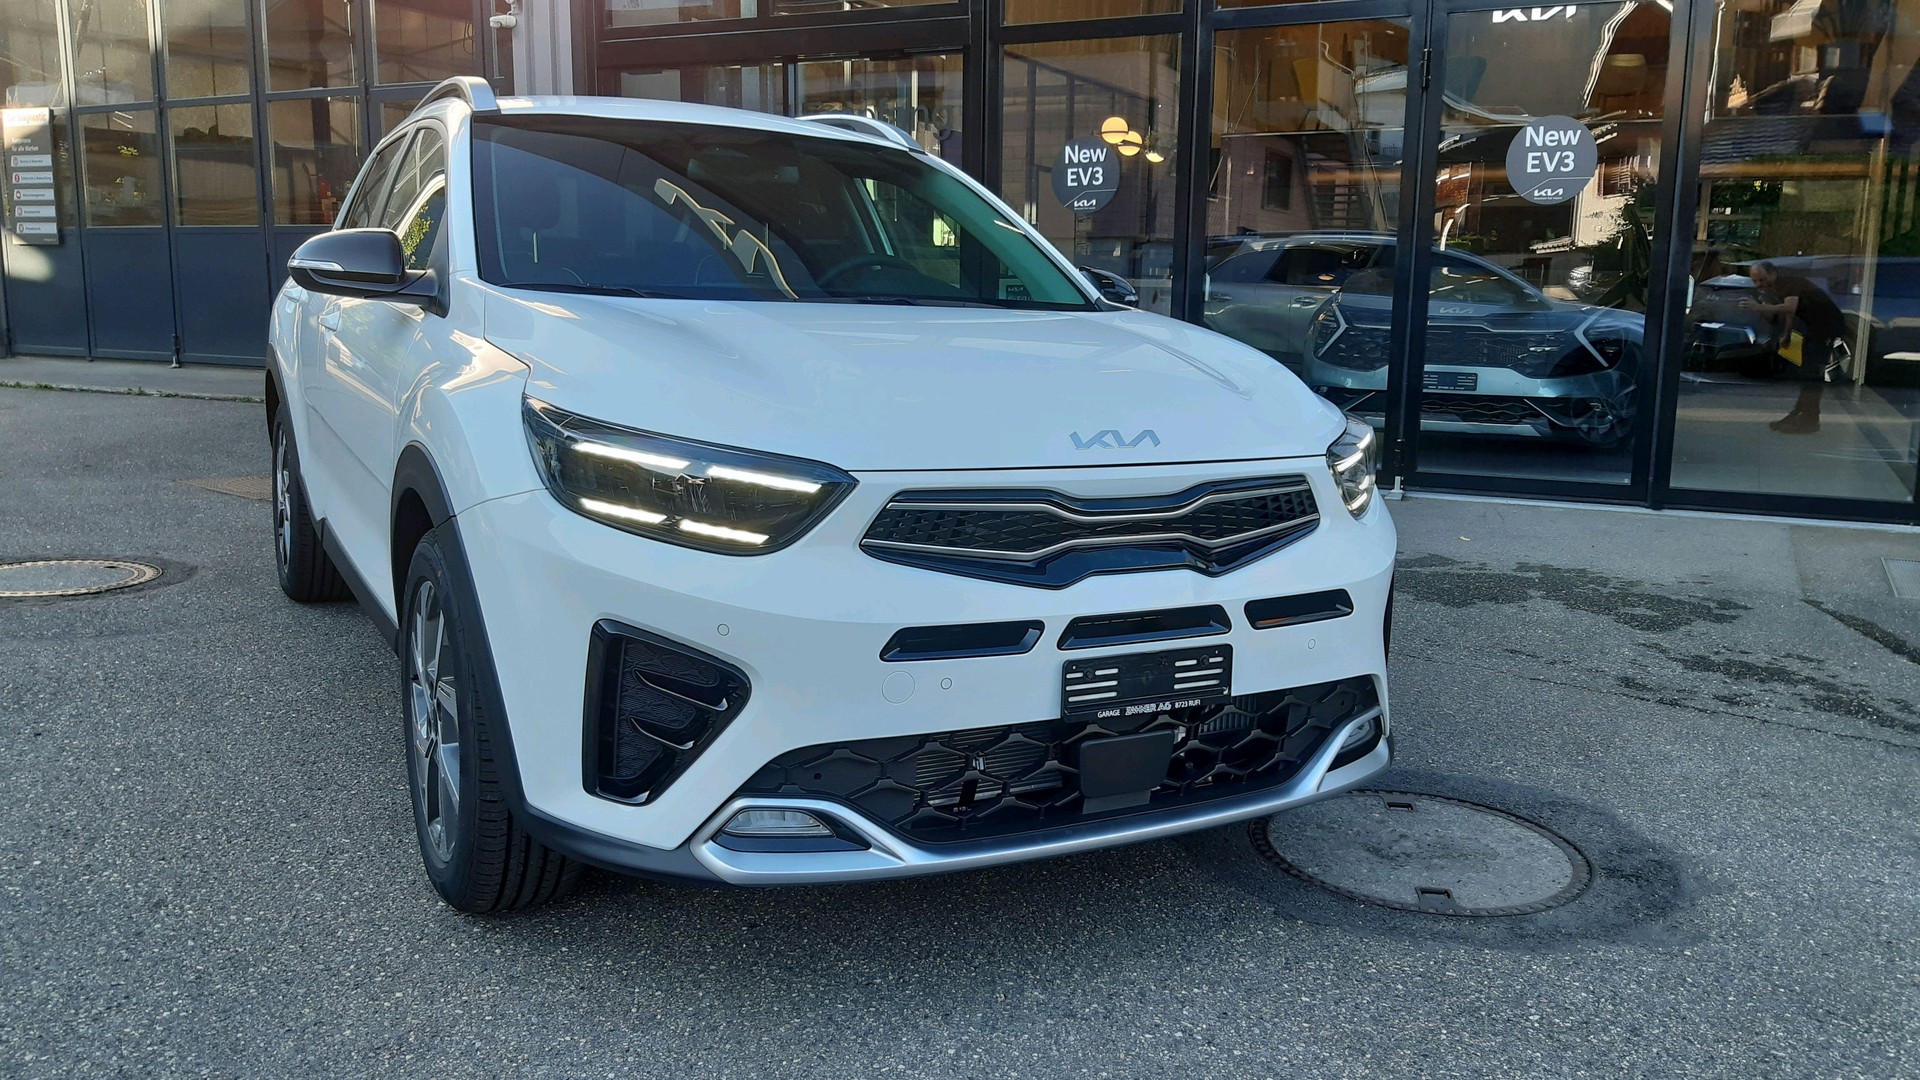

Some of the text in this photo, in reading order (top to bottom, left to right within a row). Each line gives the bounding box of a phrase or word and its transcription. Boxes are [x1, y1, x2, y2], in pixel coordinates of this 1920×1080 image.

[1525, 126, 1582, 147] New
[1065, 145, 1107, 164] New
[1526, 151, 1575, 173] EV3
[1067, 166, 1104, 187] EV3
[1069, 429, 1161, 450] KIA
[1097, 709, 1121, 718] GARAGE
[1157, 701, 1172, 711] AG
[1174, 701, 1188, 709] 8723
[1188, 699, 1201, 707] RUFI
